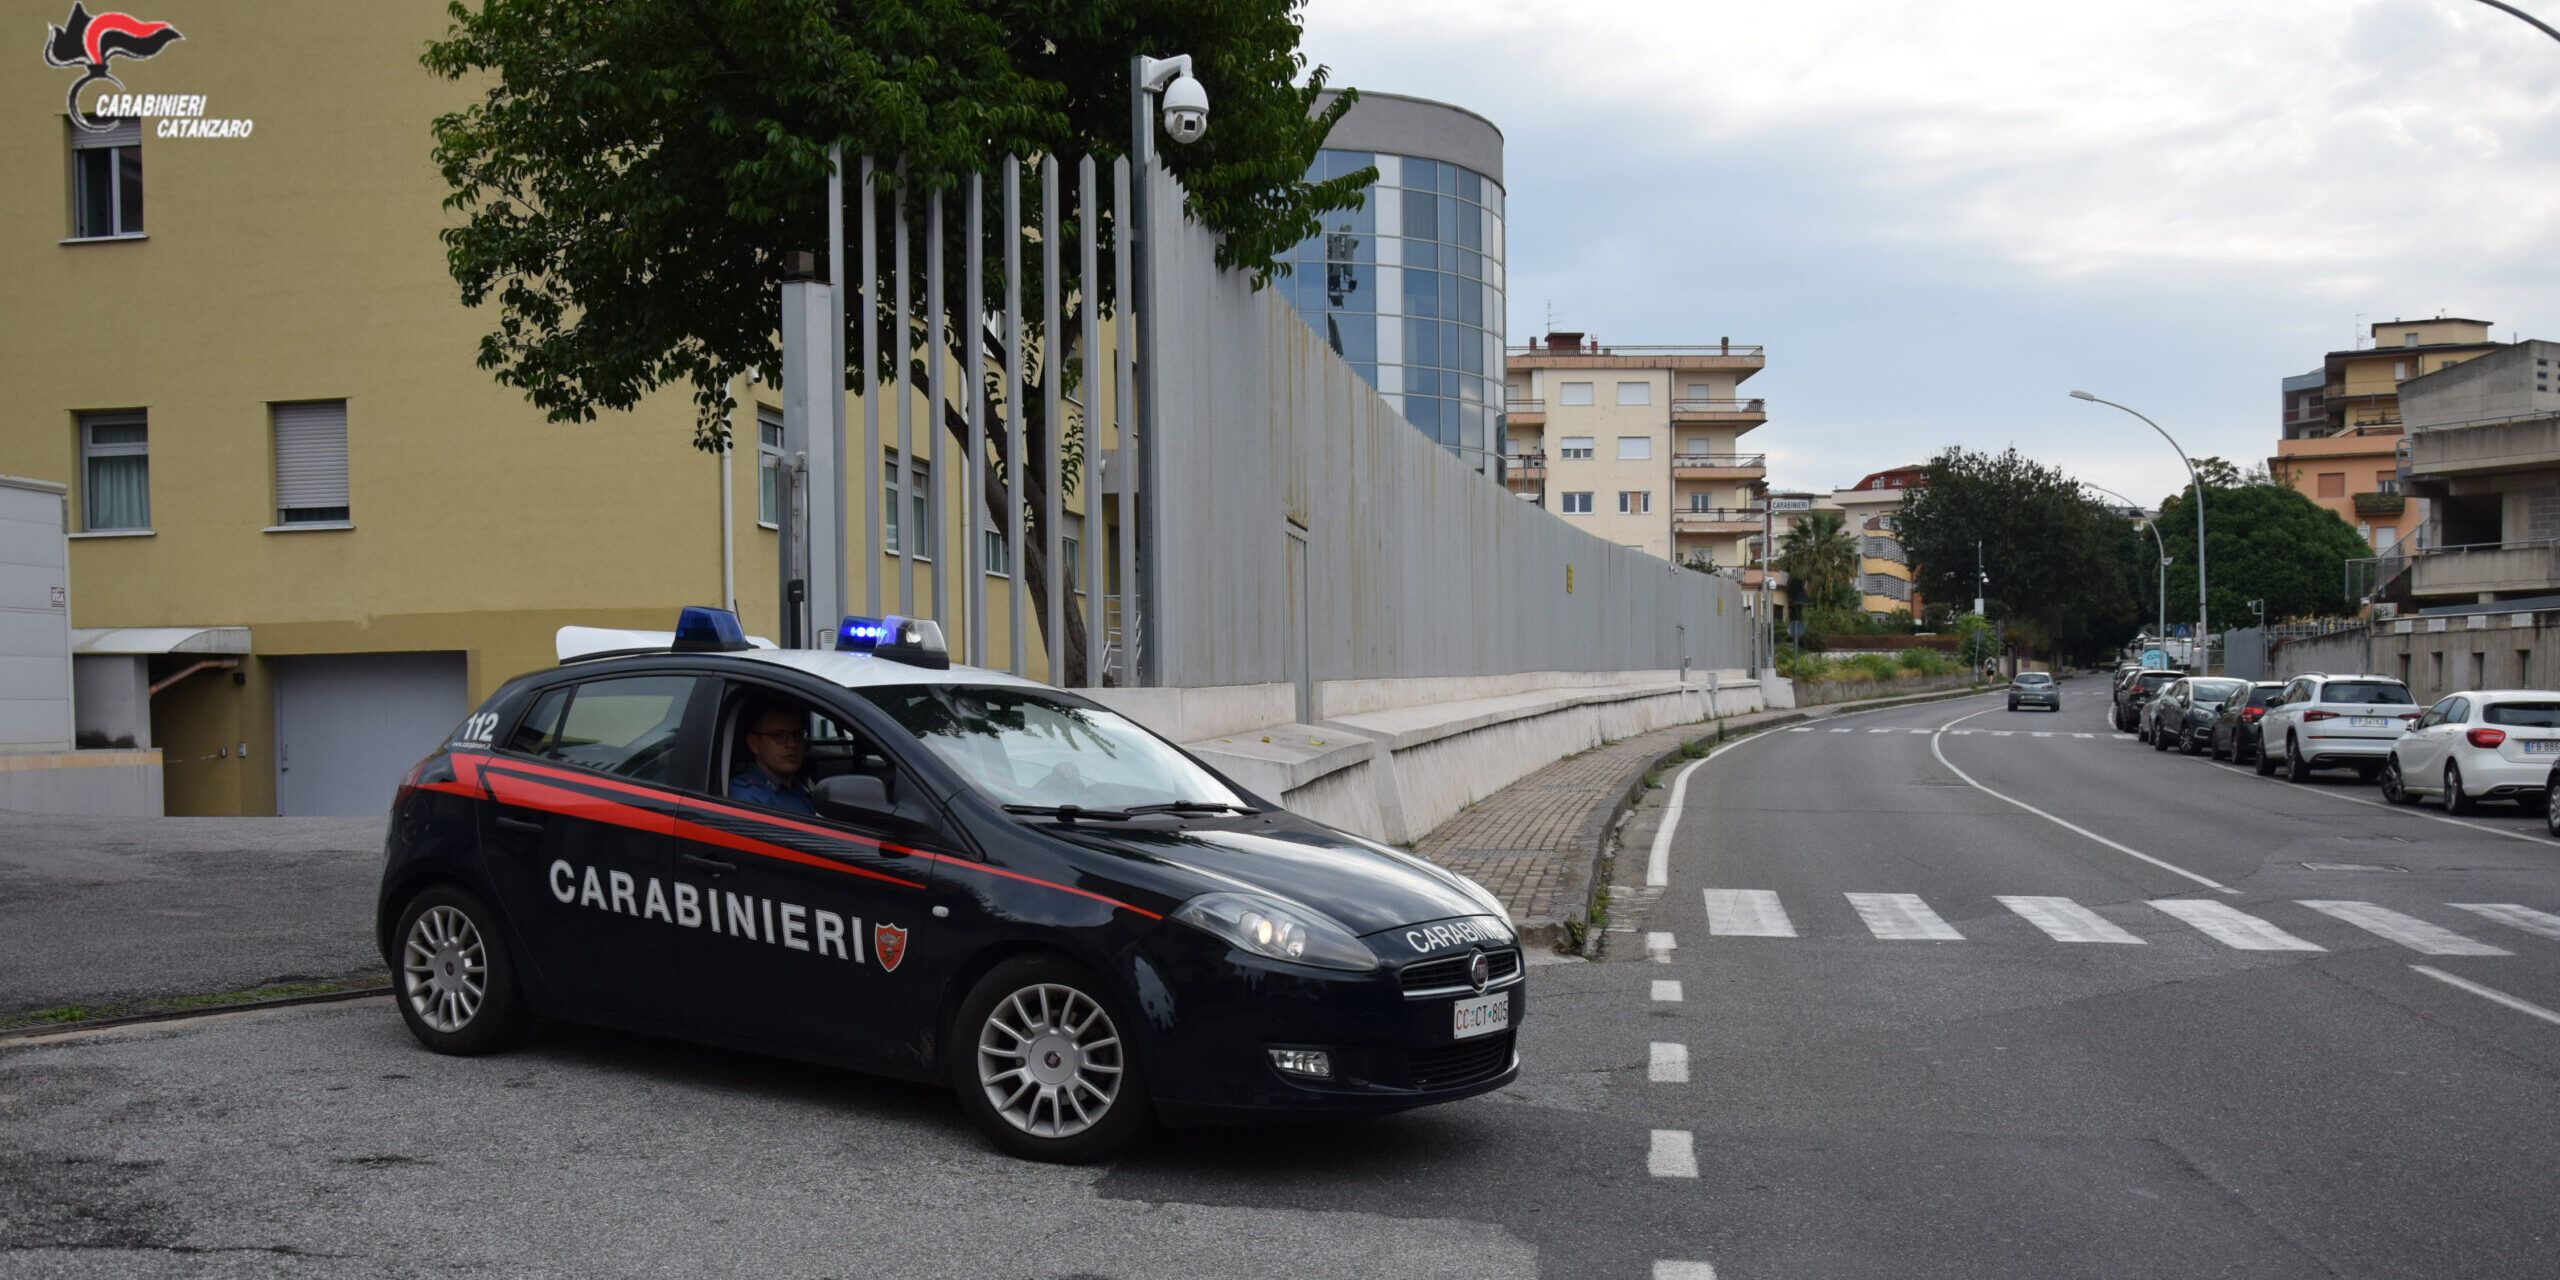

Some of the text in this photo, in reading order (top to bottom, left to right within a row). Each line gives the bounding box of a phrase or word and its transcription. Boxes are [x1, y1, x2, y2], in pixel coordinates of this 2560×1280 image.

[1772, 500, 1808, 509] CARABINIERI
[463, 711, 499, 742] 112
[549, 858, 866, 964] CARABINIERI
